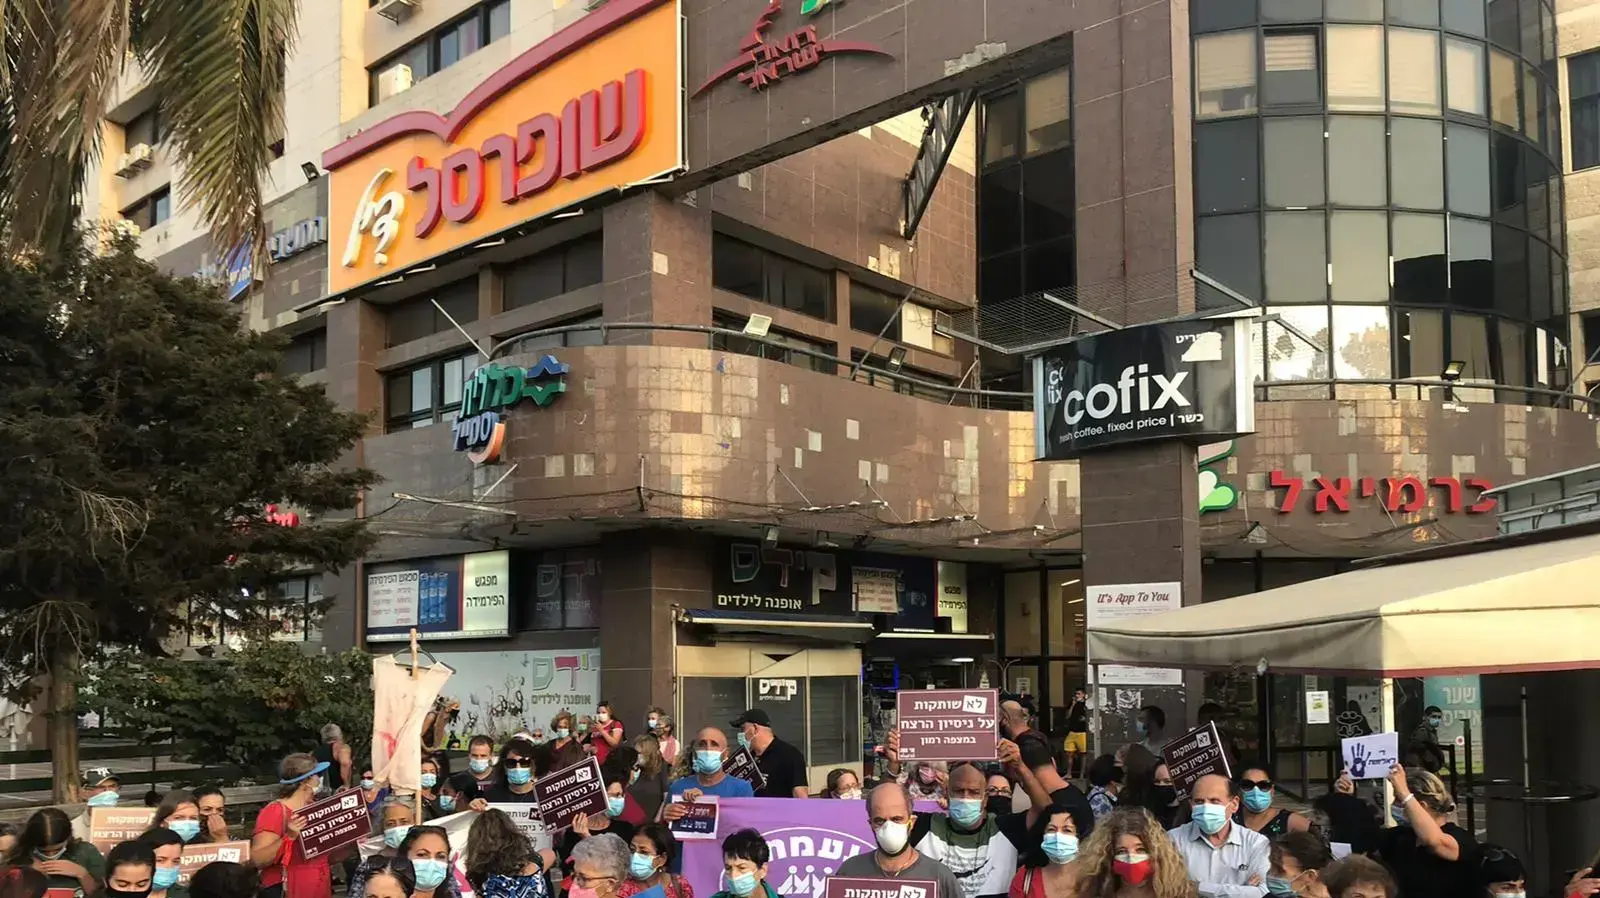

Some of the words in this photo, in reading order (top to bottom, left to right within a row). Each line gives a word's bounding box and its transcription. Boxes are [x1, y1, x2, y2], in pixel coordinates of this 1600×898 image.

[749, 24, 817, 62] דואר
[737, 44, 824, 90] ישראל
[407, 68, 647, 239] שופרסל
[460, 363, 528, 418] כללית
[1063, 363, 1192, 425] cofix
[452, 411, 500, 451] סמייל
[1074, 425, 1105, 439] coffee.
[1107, 418, 1134, 433] fixed
[1136, 415, 1167, 430] price
[1177, 412, 1204, 424] כשר
[1269, 470, 1499, 513] כרמיאל
[474, 575, 498, 588] מפגש
[466, 594, 505, 608] הפירמידה
[718, 594, 761, 607] לילדים
[765, 597, 802, 610] אופנה
[1116, 592, 1136, 605] App
[1137, 591, 1150, 602] To
[1151, 591, 1170, 602] You
[759, 679, 797, 701] קידס
[531, 693, 561, 705] לילדים
[563, 694, 592, 705] אופנה
[913, 699, 963, 711] שותקות
[966, 697, 983, 709] לא
[900, 719, 934, 729] הרצח
[938, 719, 974, 731] ניסיון
[976, 717, 995, 729] על
[920, 737, 941, 746] רמון
[943, 735, 977, 744] במצפה
[1172, 740, 1198, 759] שותקות
[1208, 747, 1220, 757] על
[1189, 752, 1209, 768] ניסיון
[1170, 762, 1189, 777] הרצח
[545, 775, 576, 794] שותקות
[588, 781, 600, 790] על
[564, 786, 588, 803] ניסיון
[308, 803, 341, 821] שותקות
[353, 807, 367, 817] על
[541, 798, 563, 812] הרצח
[571, 798, 593, 812] במצפה
[327, 813, 353, 829] ניסיון
[556, 809, 571, 819] רמון
[301, 824, 326, 838] הרצח
[334, 823, 357, 836] במצפה
[318, 832, 334, 844] רמון
[179, 853, 218, 866] שותקו
[844, 888, 899, 898] שותקות
